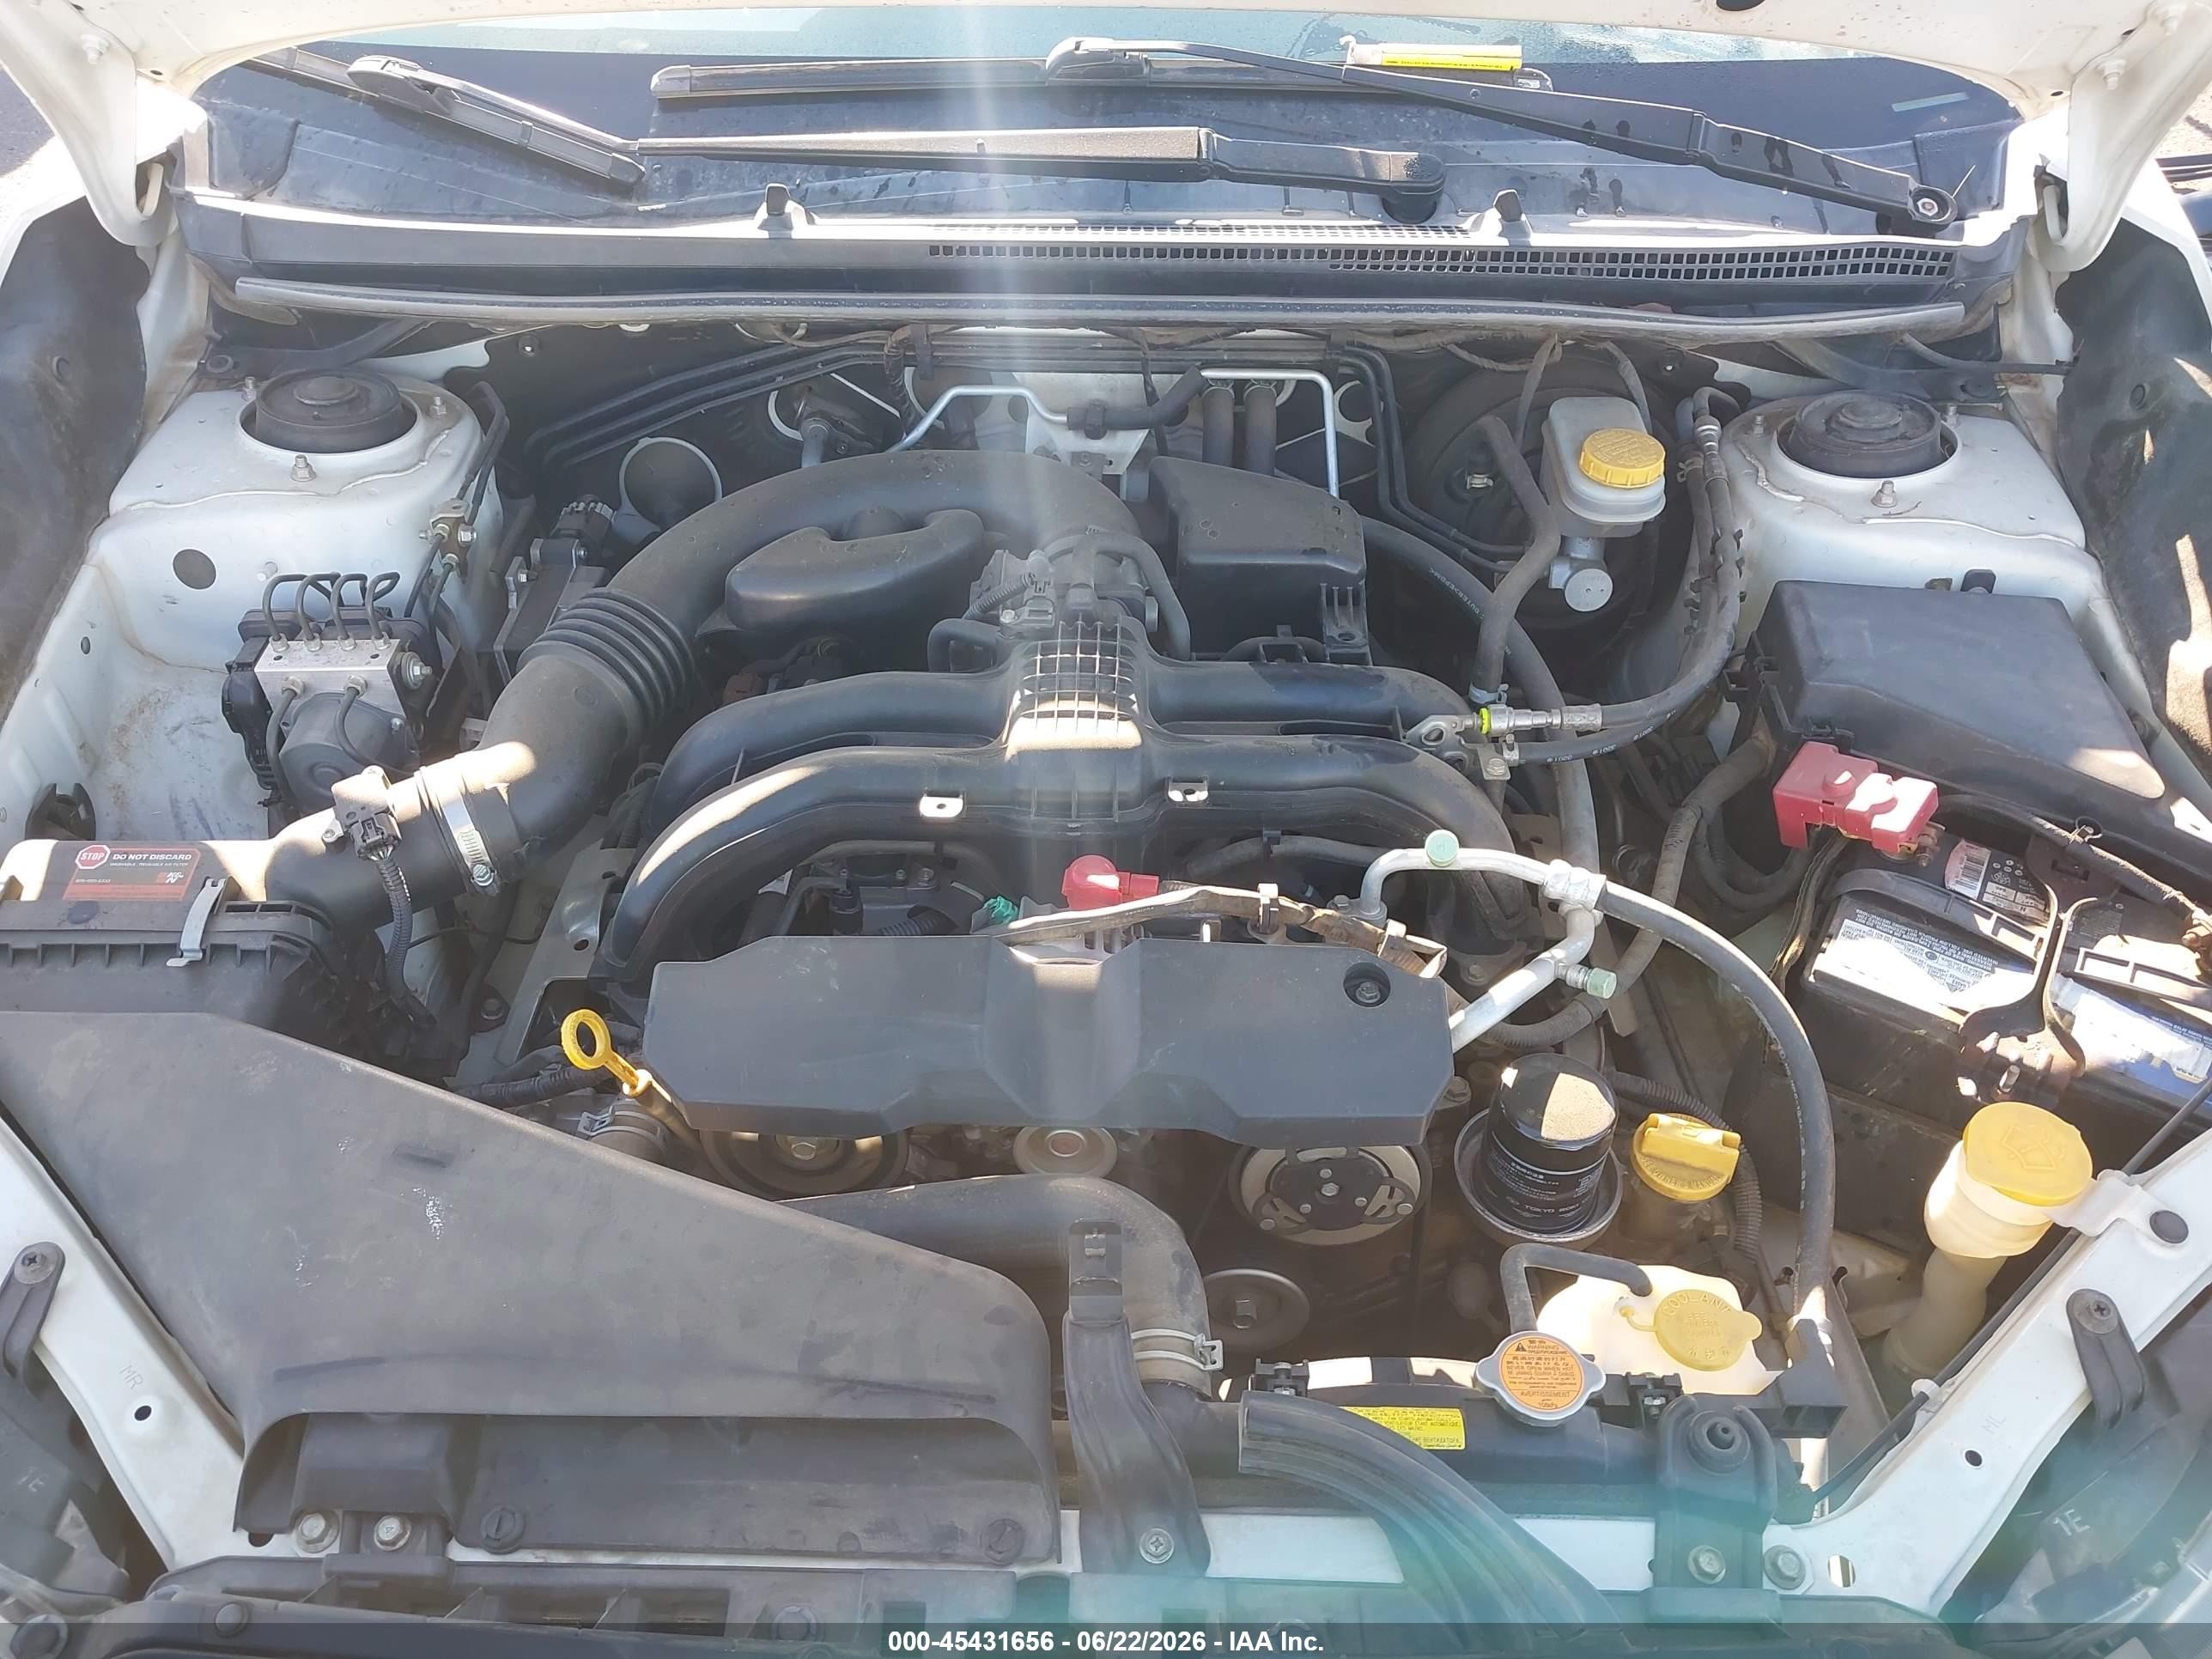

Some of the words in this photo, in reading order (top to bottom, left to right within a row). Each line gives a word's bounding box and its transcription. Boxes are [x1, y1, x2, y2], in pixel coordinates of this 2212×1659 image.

[81, 852, 105, 861] STOP
[1663, 1291, 1732, 1316] COOLANT
[118, 1363, 144, 1390] MR
[1980, 1416, 2007, 1435] ML
[2053, 1509, 2090, 1536] 1E
